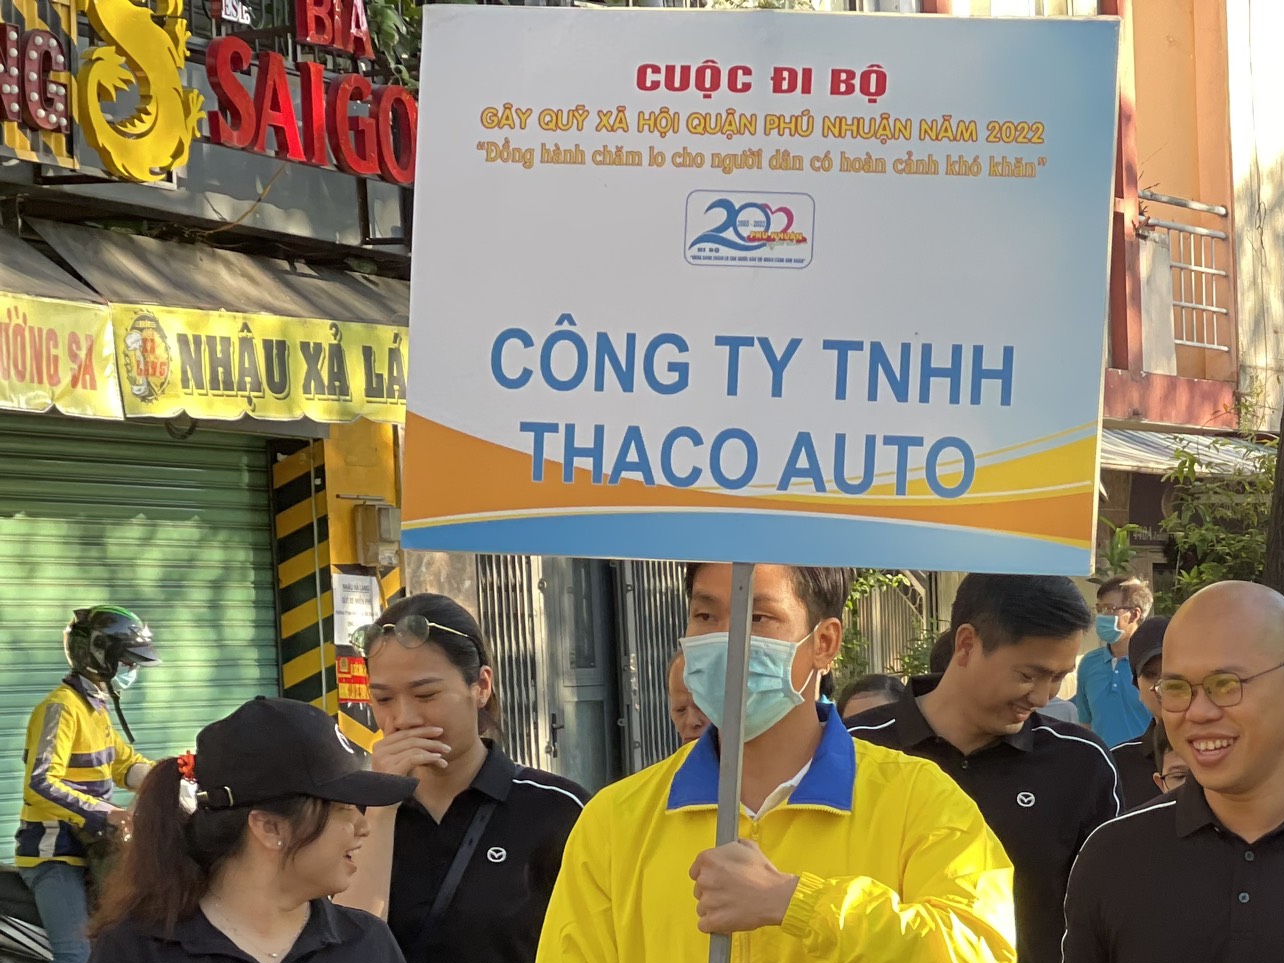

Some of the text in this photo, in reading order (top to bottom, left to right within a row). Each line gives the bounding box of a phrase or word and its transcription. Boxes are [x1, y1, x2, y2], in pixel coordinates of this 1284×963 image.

[296, 0, 374, 60] BIA
[636, 59, 888, 104] CUỘC ĐI BỘ
[480, 103, 1045, 144] GÂY QUỸ XÃ HỘI QUẬN PHÚ NHUẬN NĂM 2022
[540, 143, 586, 166] hành
[591, 145, 643, 167] chăm
[649, 146, 666, 167] lo
[671, 146, 705, 169] cho
[711, 148, 763, 174] người
[769, 149, 804, 171] dân
[810, 150, 834, 173] có
[839, 152, 887, 174] hoàn
[893, 150, 939, 175] cảnh
[945, 154, 982, 177] khó
[67, 331, 98, 390] SA
[178, 322, 291, 412] NHẬU
[300, 322, 352, 401] XẢ
[490, 312, 1015, 407] CÔNG TY TNHH
[519, 421, 977, 499] THACO AUTO
